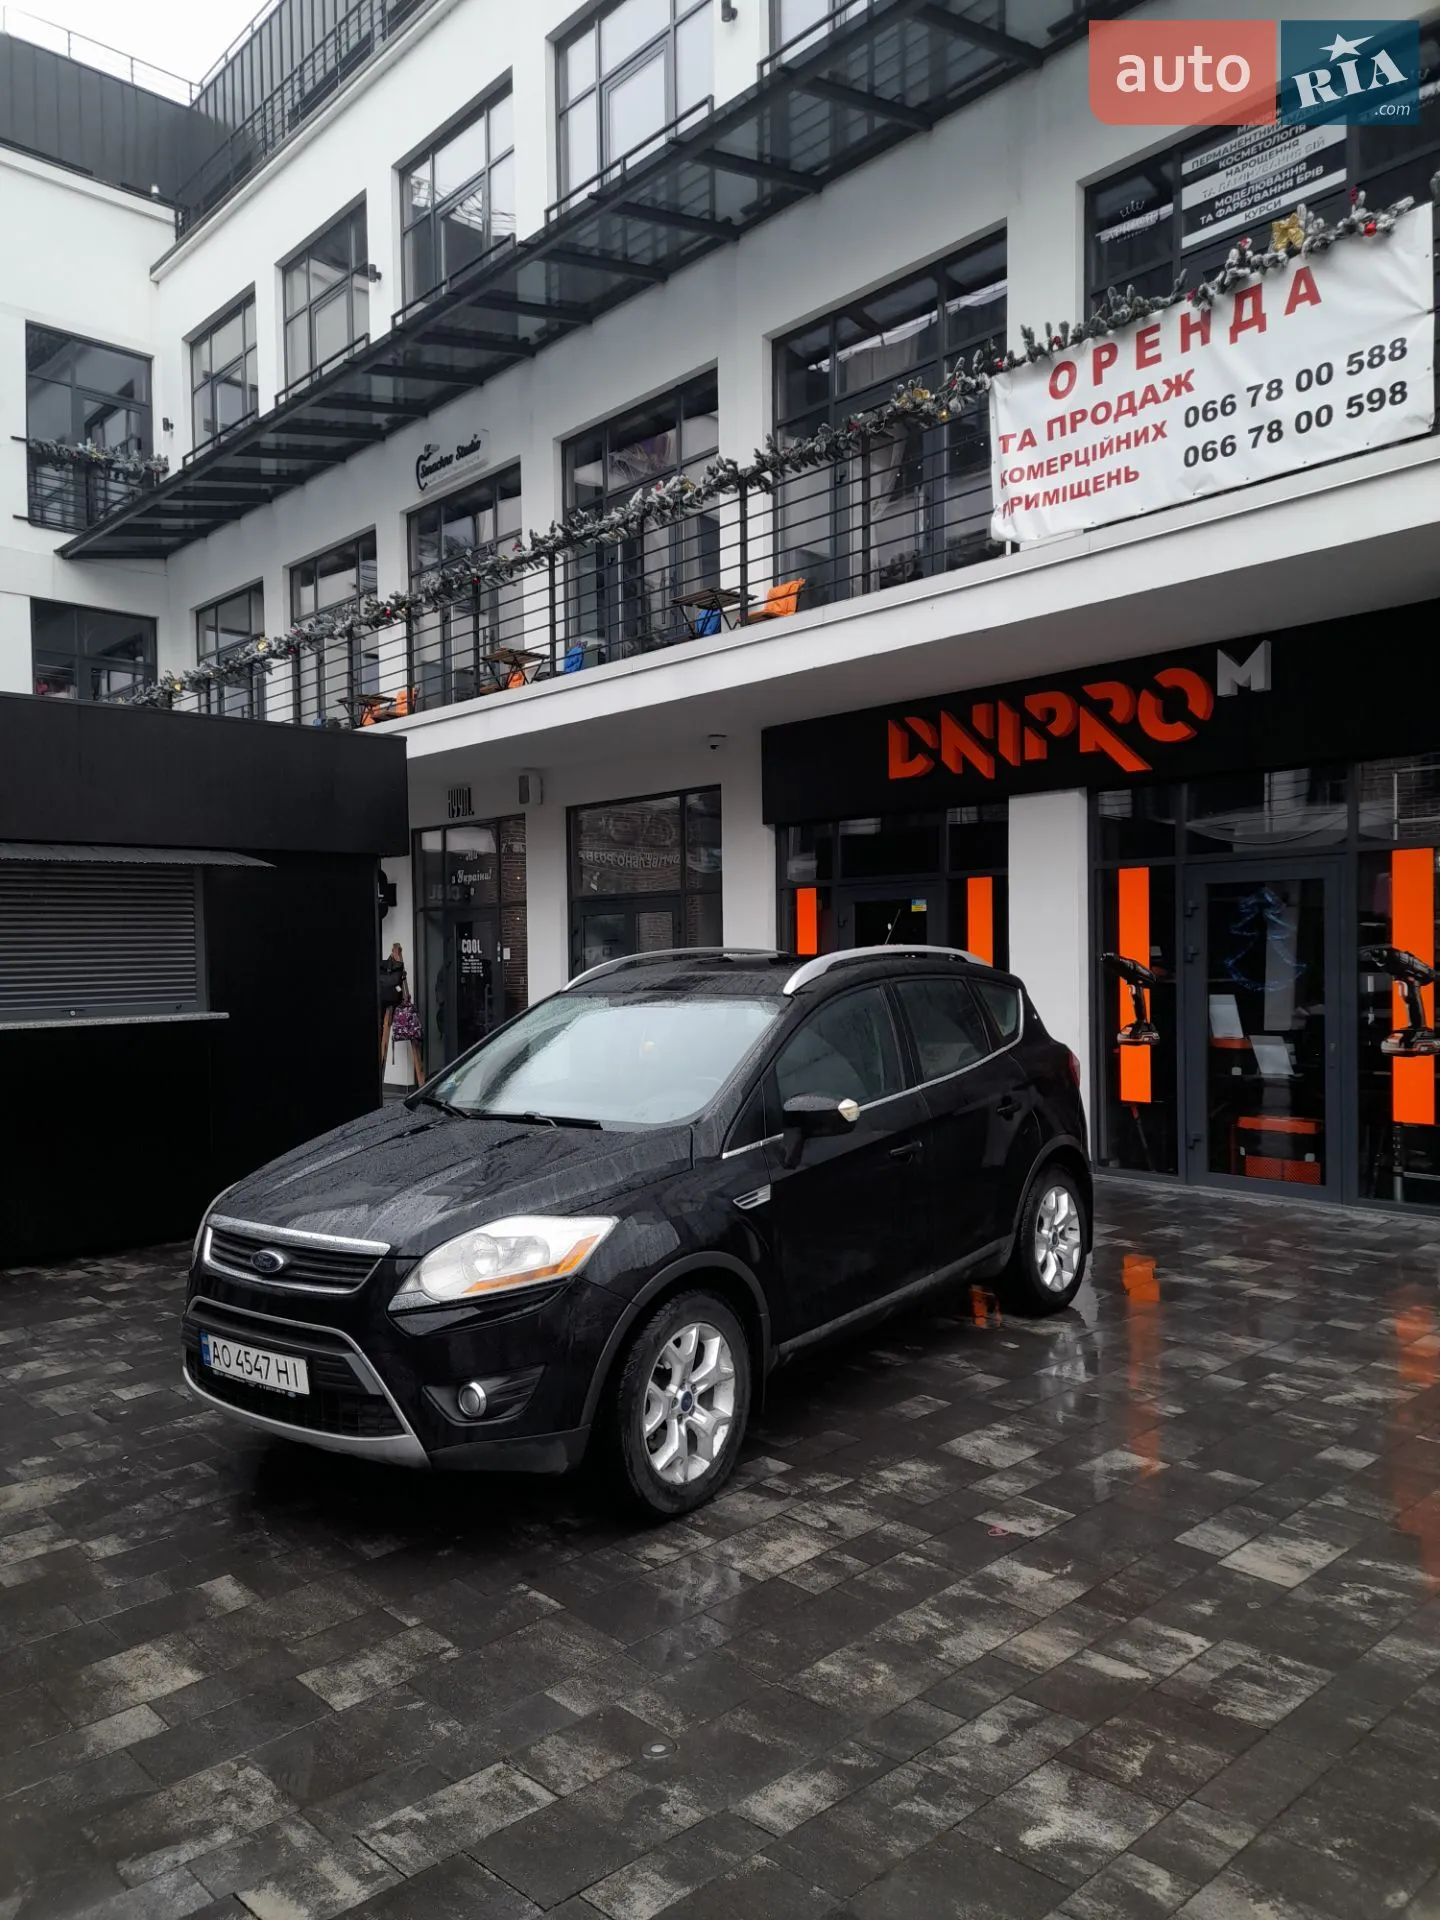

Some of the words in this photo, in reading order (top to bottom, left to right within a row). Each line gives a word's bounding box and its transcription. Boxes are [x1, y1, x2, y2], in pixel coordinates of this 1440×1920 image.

[1218, 123, 1306, 169] КОСМЕТОЛОГІЯ
[1225, 138, 1300, 178] НАРОЩЕННЯ
[1200, 214, 1214, 225] ТА
[1215, 178, 1294, 218] ФАРБУВАННЯ
[1296, 165, 1324, 185] БРІВ
[1214, 162, 1307, 209] МОДЕЛЮВАННЯ
[1244, 199, 1282, 221] КУРСИ
[1048, 266, 1322, 400] ОРЕНДА
[998, 427, 1037, 454] ТА
[1046, 368, 1196, 441] ПРОДАЖ
[1184, 393, 1237, 428] 066
[1246, 378, 1284, 408] 78
[1295, 361, 1334, 392] 00
[1346, 337, 1408, 376] 588
[1183, 434, 1237, 468] 066
[1247, 419, 1284, 449] 78
[1295, 404, 1334, 434] 00
[1345, 380, 1408, 419] 598
[1000, 420, 1168, 489] КОМЕРЦІЙНИХ
[1002, 465, 1140, 520] ПРИМІЩЕНЬ
[888, 666, 1215, 781] DNIPRO
[1216, 639, 1272, 698] M
[212, 1341, 232, 1368] AO
[235, 1349, 270, 1380] 4547
[275, 1358, 299, 1388] HI
